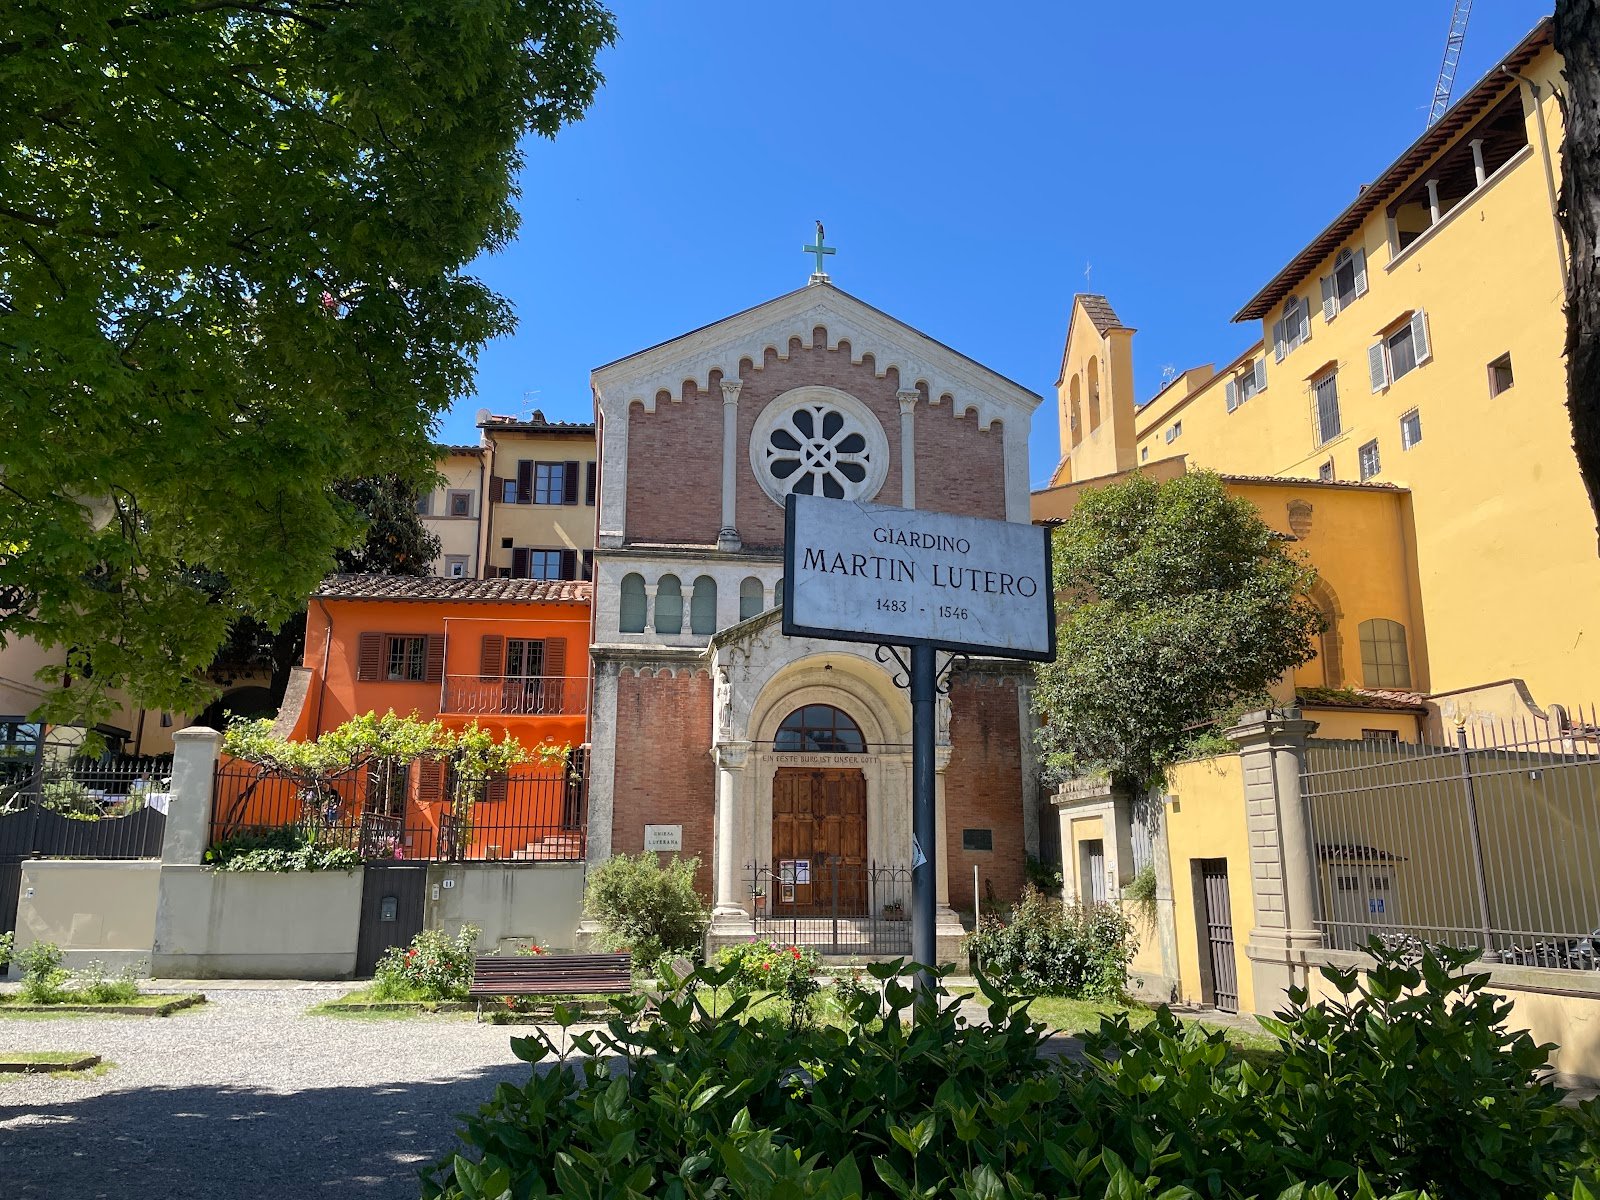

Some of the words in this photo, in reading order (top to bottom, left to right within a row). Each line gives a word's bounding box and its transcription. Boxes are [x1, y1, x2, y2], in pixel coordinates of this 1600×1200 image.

[873, 527, 970, 554] GIARDINO
[801, 547, 915, 583] MARTIN
[932, 564, 1037, 598] LUTERO
[876, 598, 907, 613] 1483
[939, 605, 968, 620] 1546
[776, 755, 798, 763] FESTE
[800, 755, 818, 763] BURG
[834, 756, 858, 764] UNSER
[861, 756, 878, 764] GOTT
